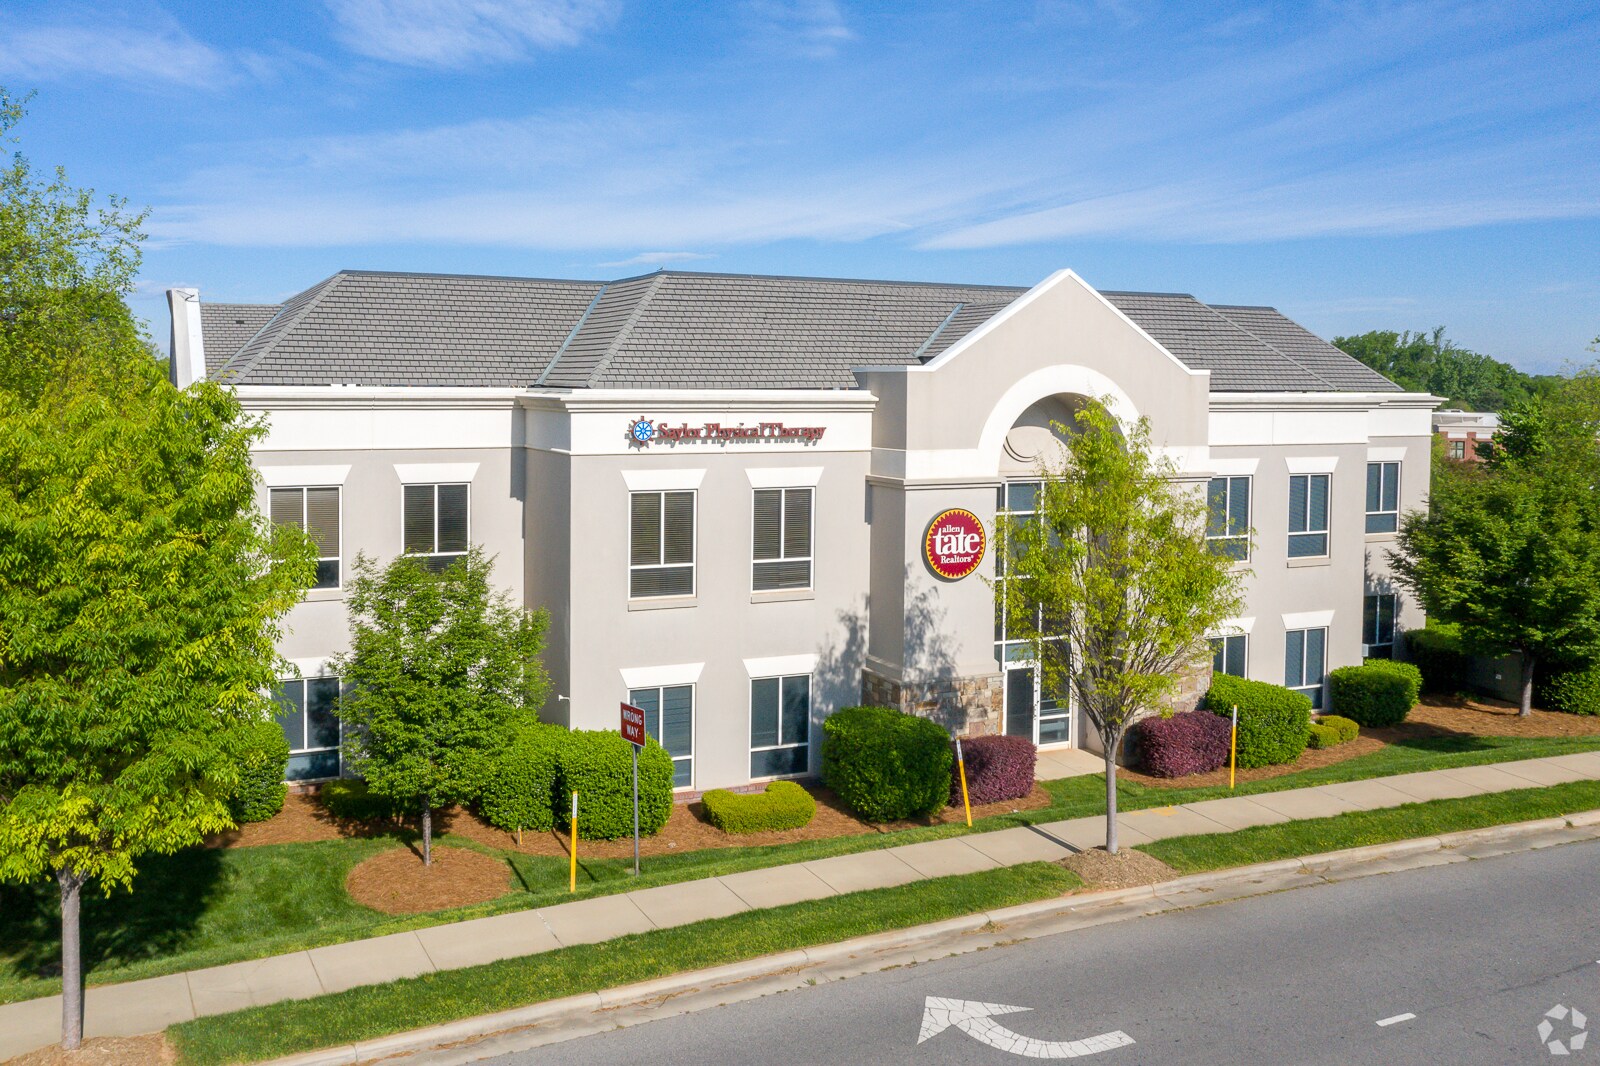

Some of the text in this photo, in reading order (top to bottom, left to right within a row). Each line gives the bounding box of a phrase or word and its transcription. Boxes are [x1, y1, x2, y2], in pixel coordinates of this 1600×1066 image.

[657, 422, 827, 442] Saylor Physical Therapy
[942, 525, 960, 533] allen
[932, 526, 980, 555] tate
[622, 709, 643, 726] WRONG
[626, 724, 639, 738] WAY
